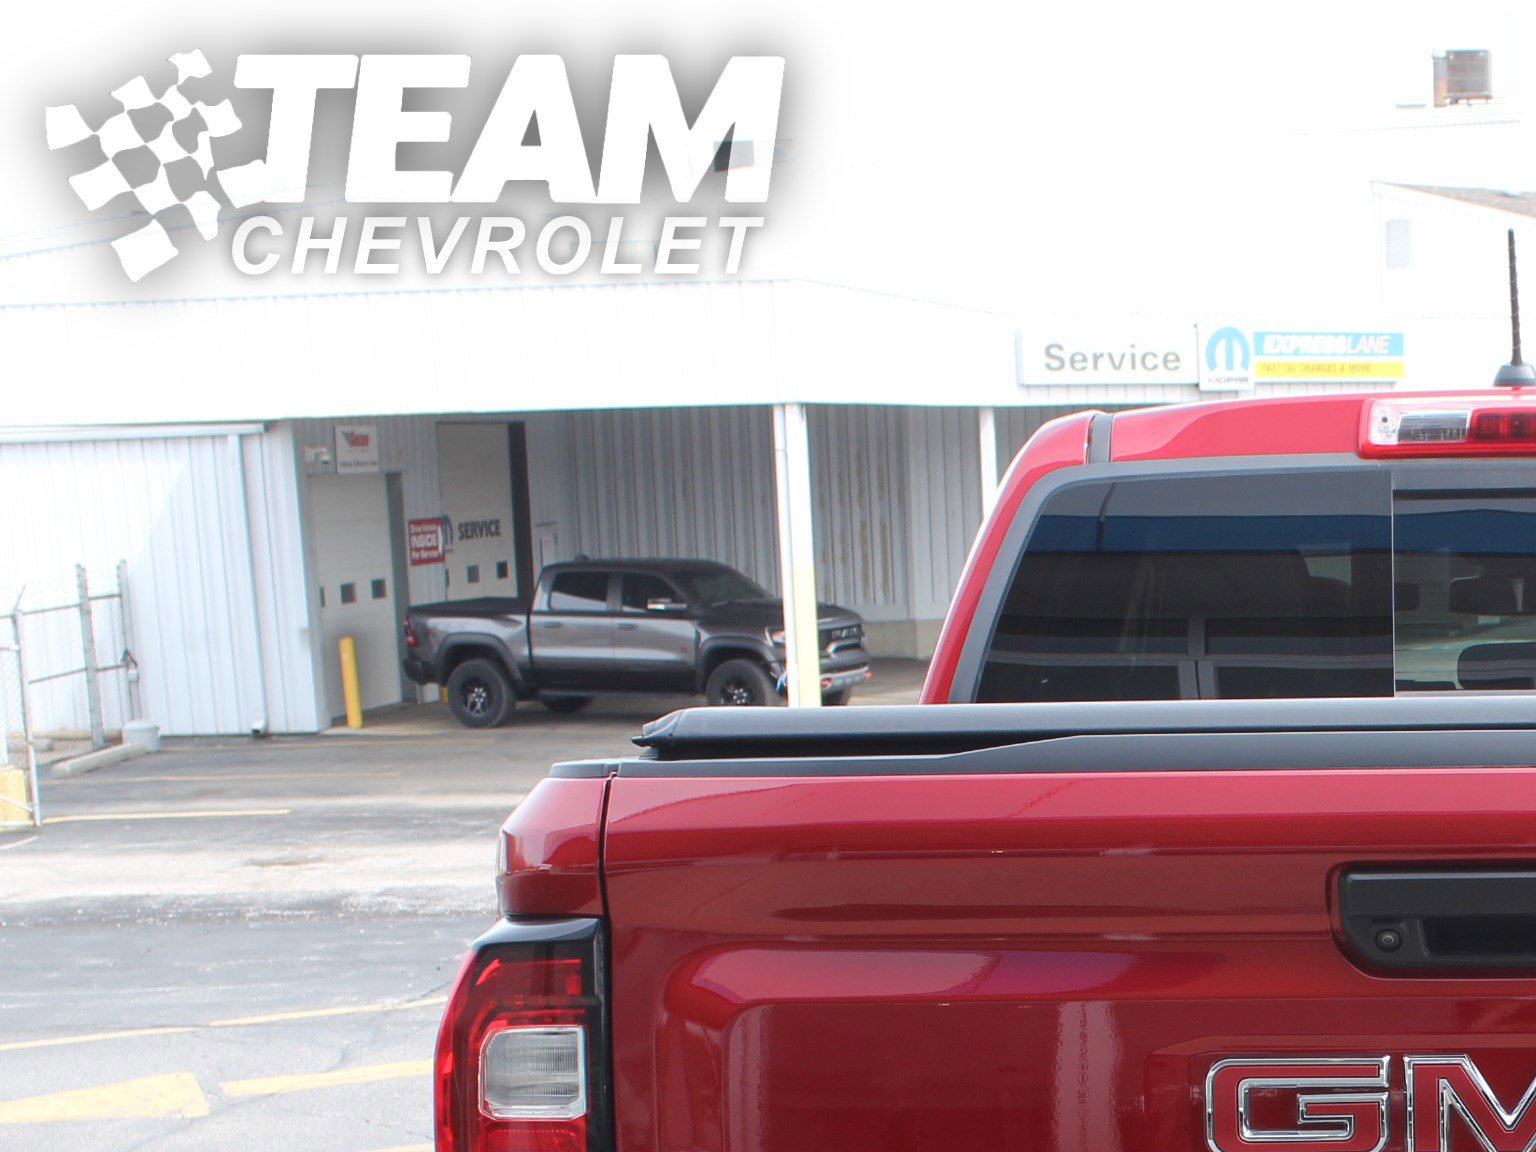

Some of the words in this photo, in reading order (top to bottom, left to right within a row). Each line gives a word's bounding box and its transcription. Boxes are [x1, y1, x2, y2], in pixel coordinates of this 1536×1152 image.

[1044, 343, 1181, 371] Service
[1208, 375, 1249, 385] MOPAR
[458, 519, 501, 541] SERVICE
